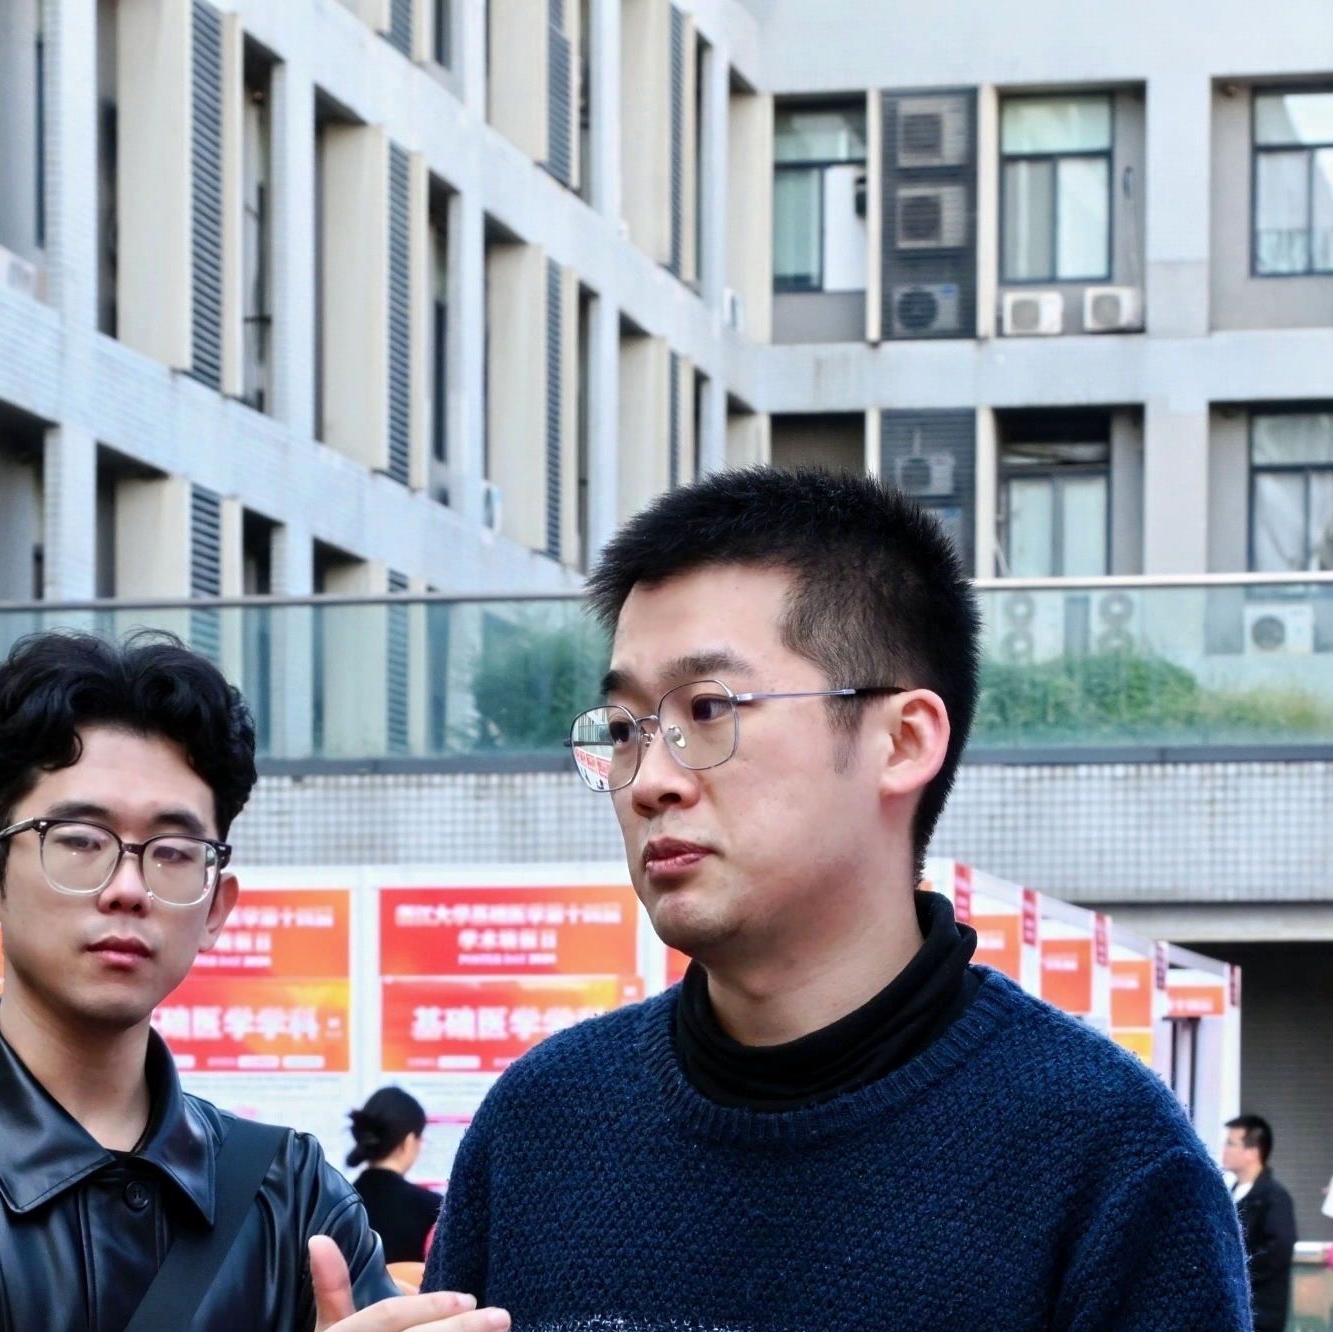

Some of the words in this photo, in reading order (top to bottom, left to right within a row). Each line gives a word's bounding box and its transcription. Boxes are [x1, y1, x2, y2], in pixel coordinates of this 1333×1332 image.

[151, 1006, 319, 1041] 础医学学科
[411, 1006, 605, 1041] 基础医学学
